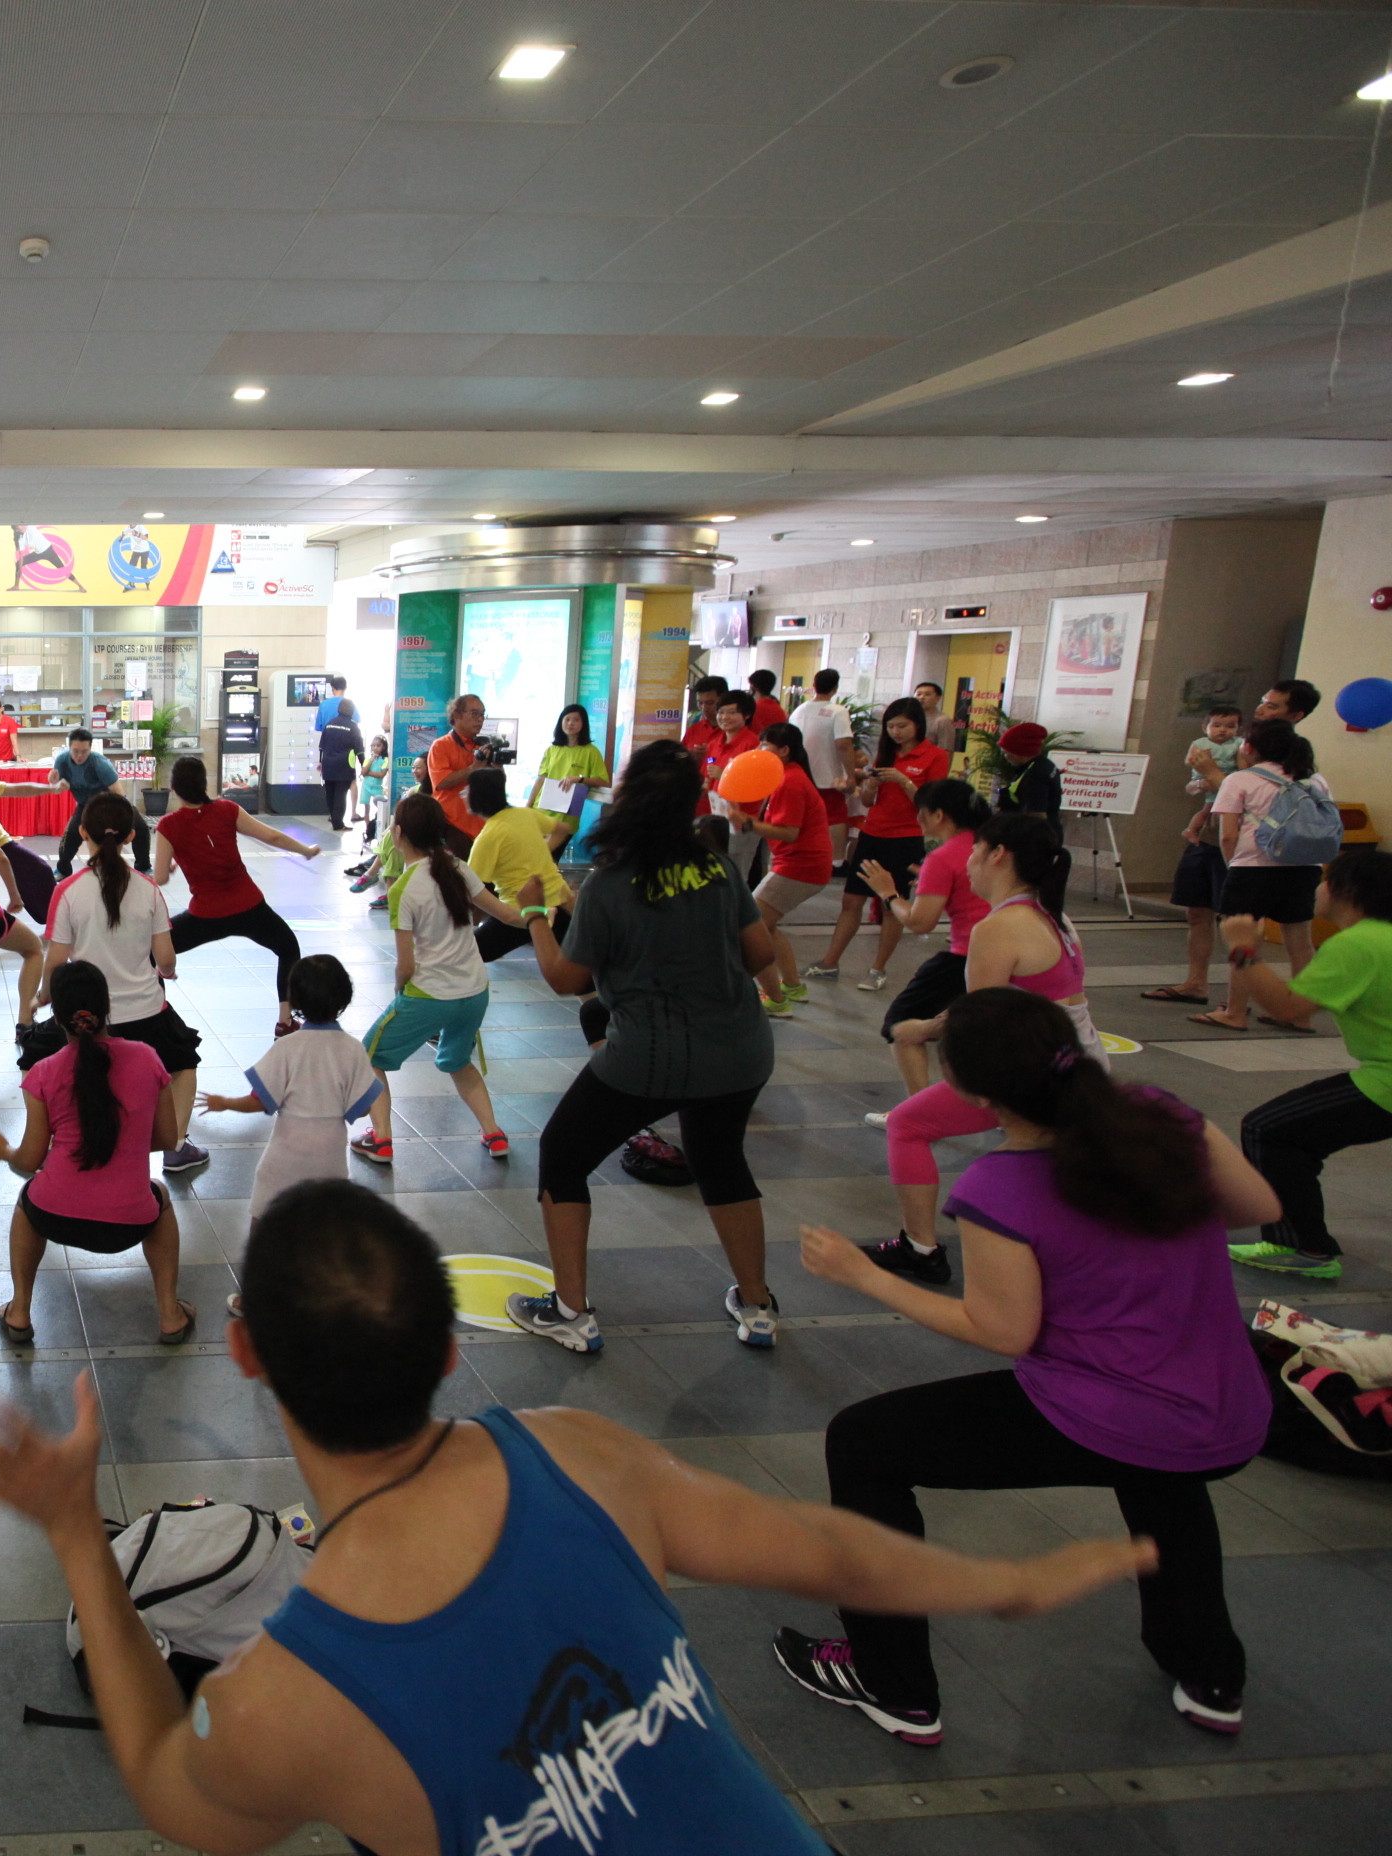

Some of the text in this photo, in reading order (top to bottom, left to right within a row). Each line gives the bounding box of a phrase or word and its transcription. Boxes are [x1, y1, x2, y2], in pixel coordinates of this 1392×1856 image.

[813, 612, 836, 629] LIFT
[928, 608, 938, 625] 2
[663, 627, 686, 636] 1994
[402, 636, 426, 646] 1967
[862, 632, 872, 648] 2
[94, 645, 105, 653] LTP
[106, 645, 135, 653] COURSES
[139, 645, 153, 653] GYM
[154, 645, 193, 653] MEMBERSHIP
[975, 690, 1004, 700] Active
[399, 697, 424, 707] 1969
[593, 699, 607, 709] 1982
[656, 710, 680, 719] 1998
[397, 757, 414, 766] 197
[1063, 777, 1120, 789] Membership
[1061, 789, 1118, 798] Verification
[1069, 799, 1092, 808] Level
[753, 1321, 770, 1329] NIKE
